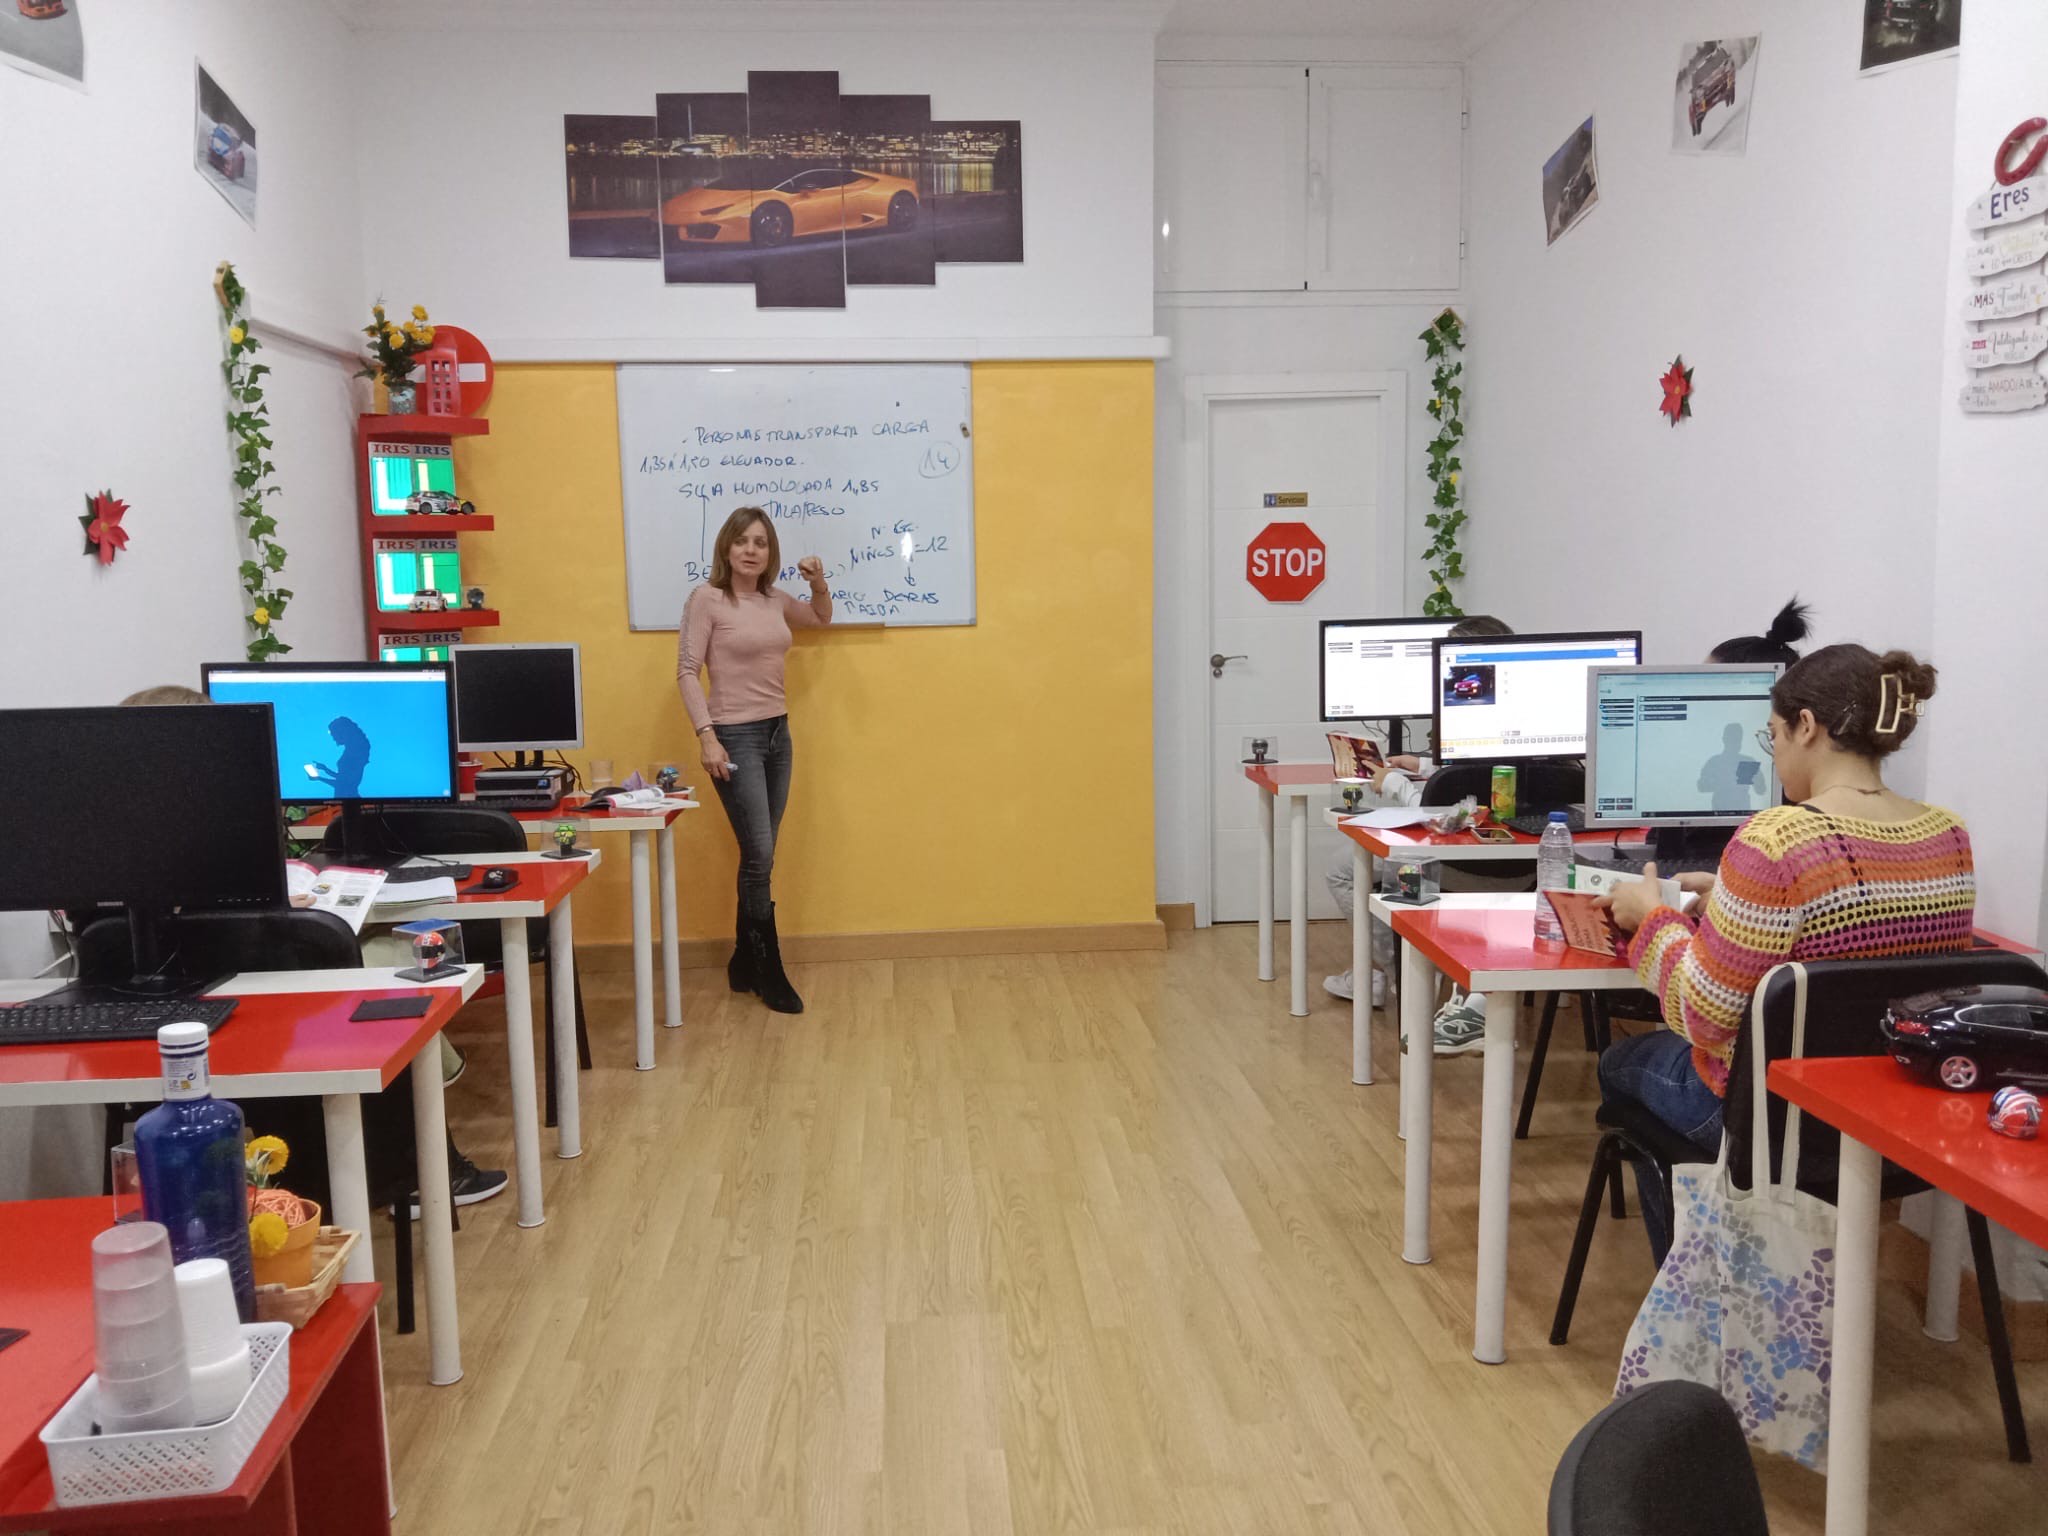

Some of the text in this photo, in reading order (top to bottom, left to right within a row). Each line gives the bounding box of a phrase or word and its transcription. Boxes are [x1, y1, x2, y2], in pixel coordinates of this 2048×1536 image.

[1991, 186, 2029, 220] Eres
[872, 419, 930, 436] CARGA
[373, 444, 451, 456] IRIS IRIS
[378, 540, 457, 550] IRIS IRIS
[1251, 548, 1323, 577] STOP
[383, 632, 461, 645] IRIS IRIS
